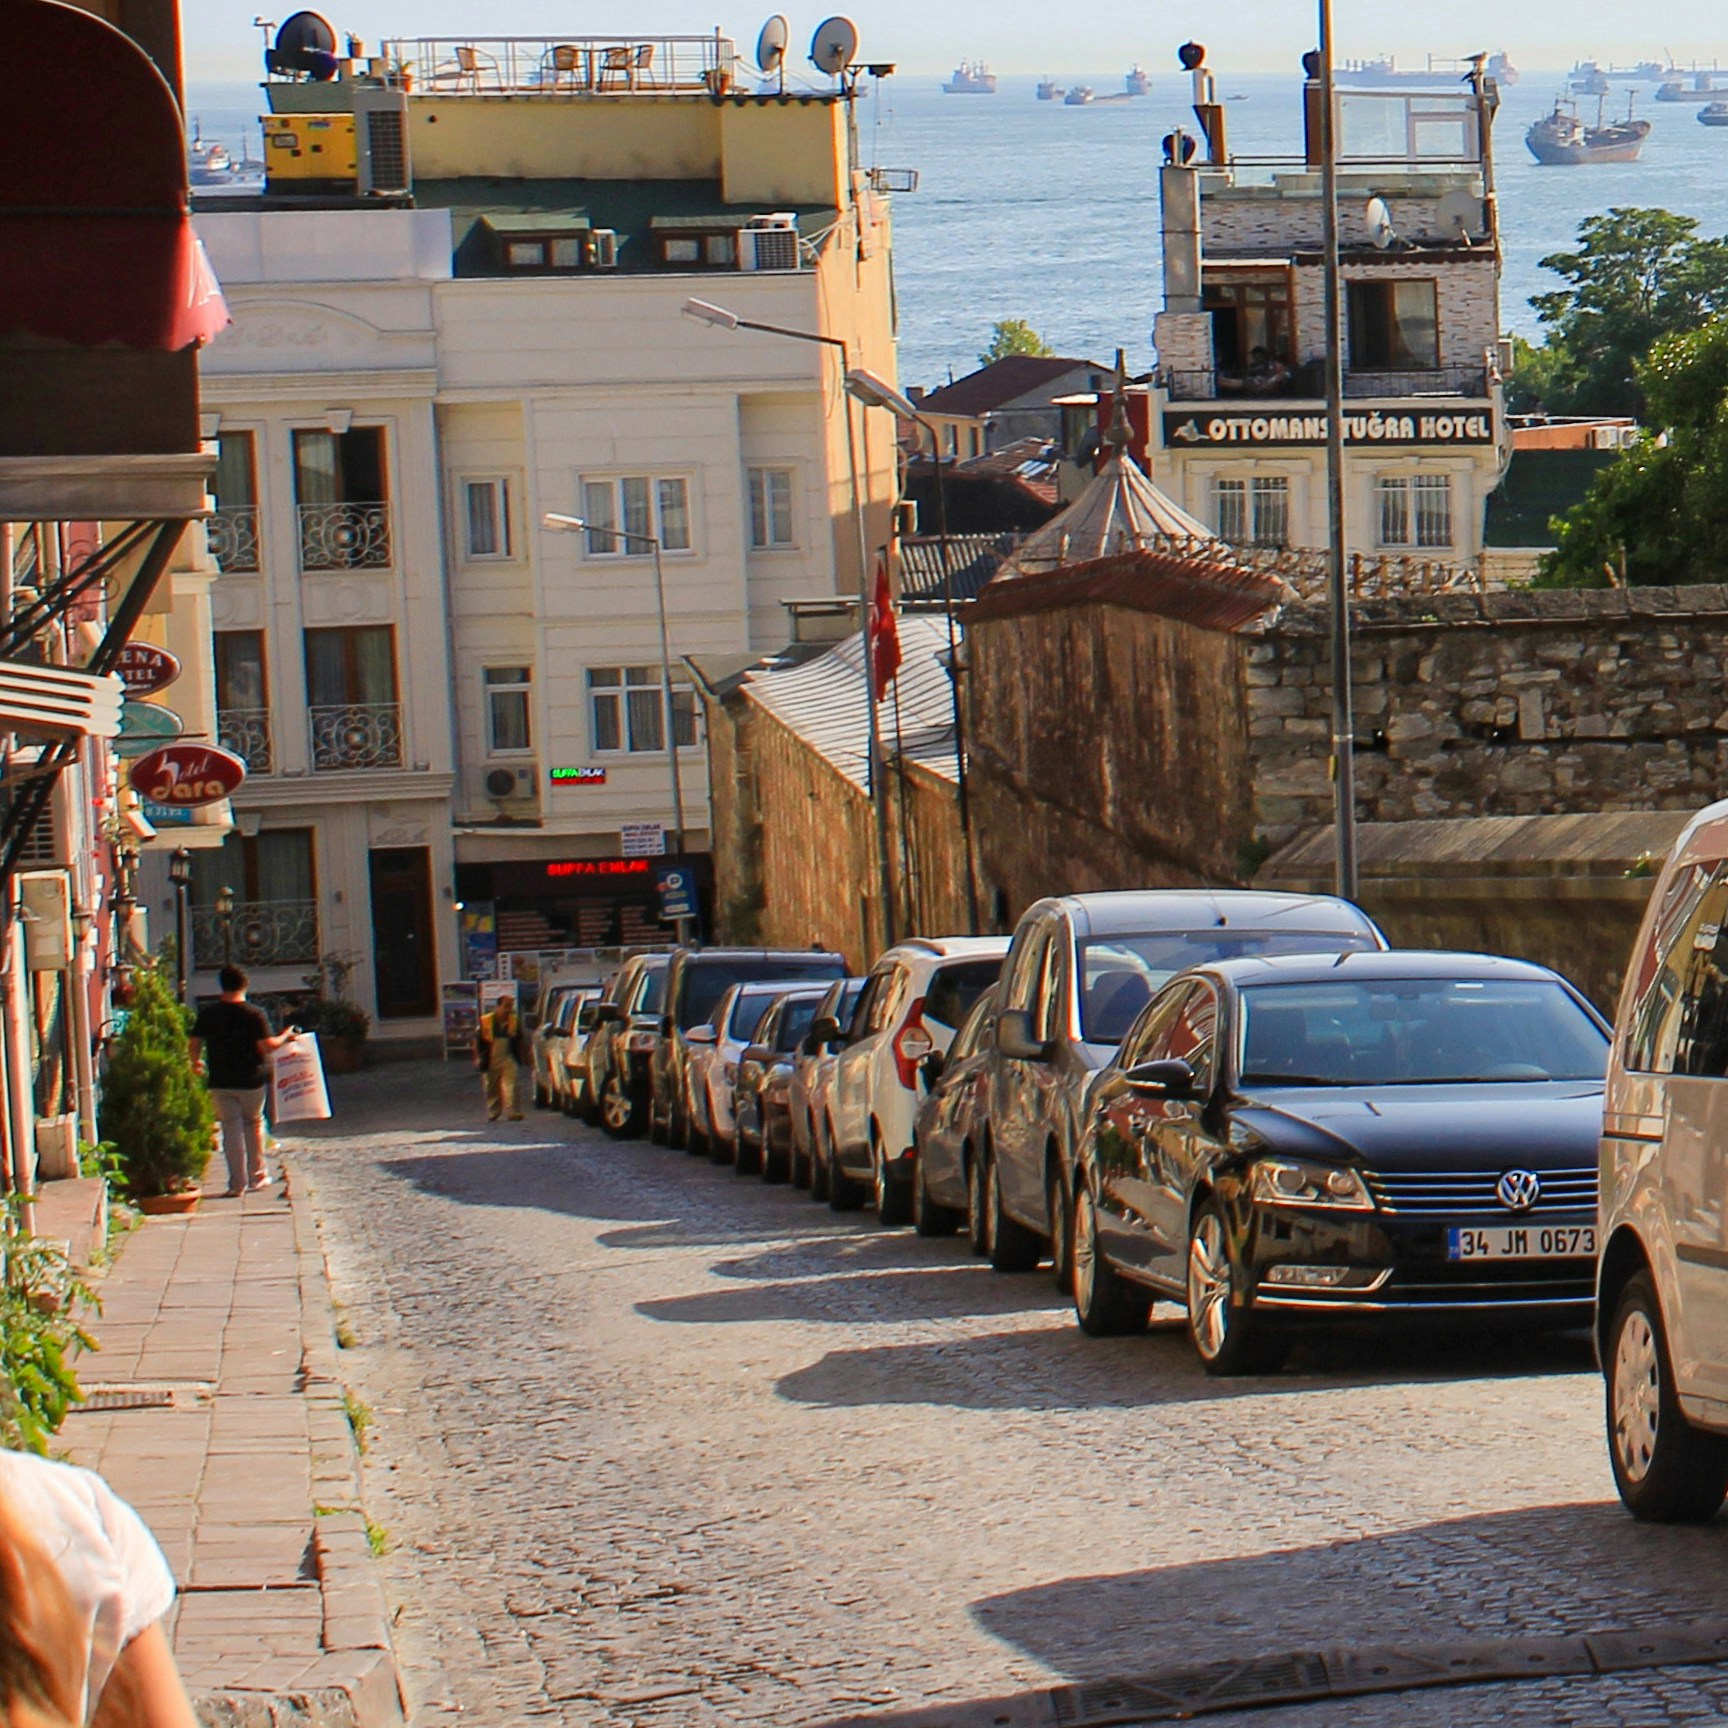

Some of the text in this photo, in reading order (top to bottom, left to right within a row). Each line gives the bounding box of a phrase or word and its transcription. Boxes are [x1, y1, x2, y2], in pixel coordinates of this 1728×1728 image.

[1208, 411, 1491, 442] OTTOMANS TUĞRA HOTEL
[1462, 1228, 1595, 1255] 34 JM 0673
